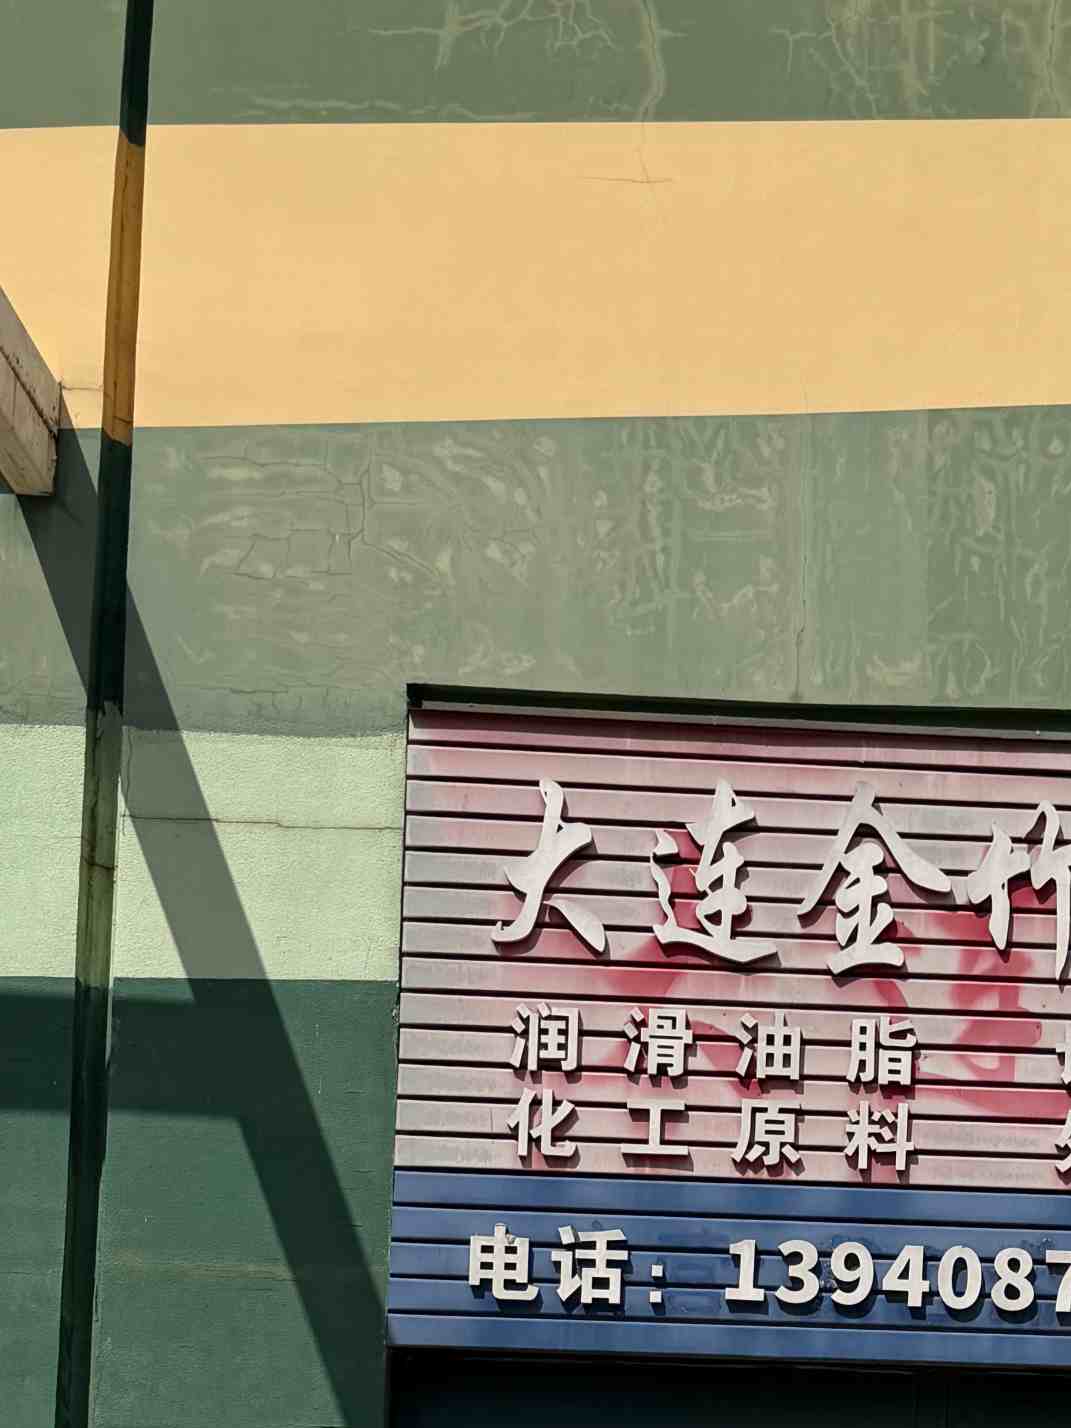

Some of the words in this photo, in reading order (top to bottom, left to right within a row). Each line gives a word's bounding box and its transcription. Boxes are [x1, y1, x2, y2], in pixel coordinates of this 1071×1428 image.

[509, 1002, 918, 1088] 润滑油脂
[506, 1088, 916, 1172] 化工原料
